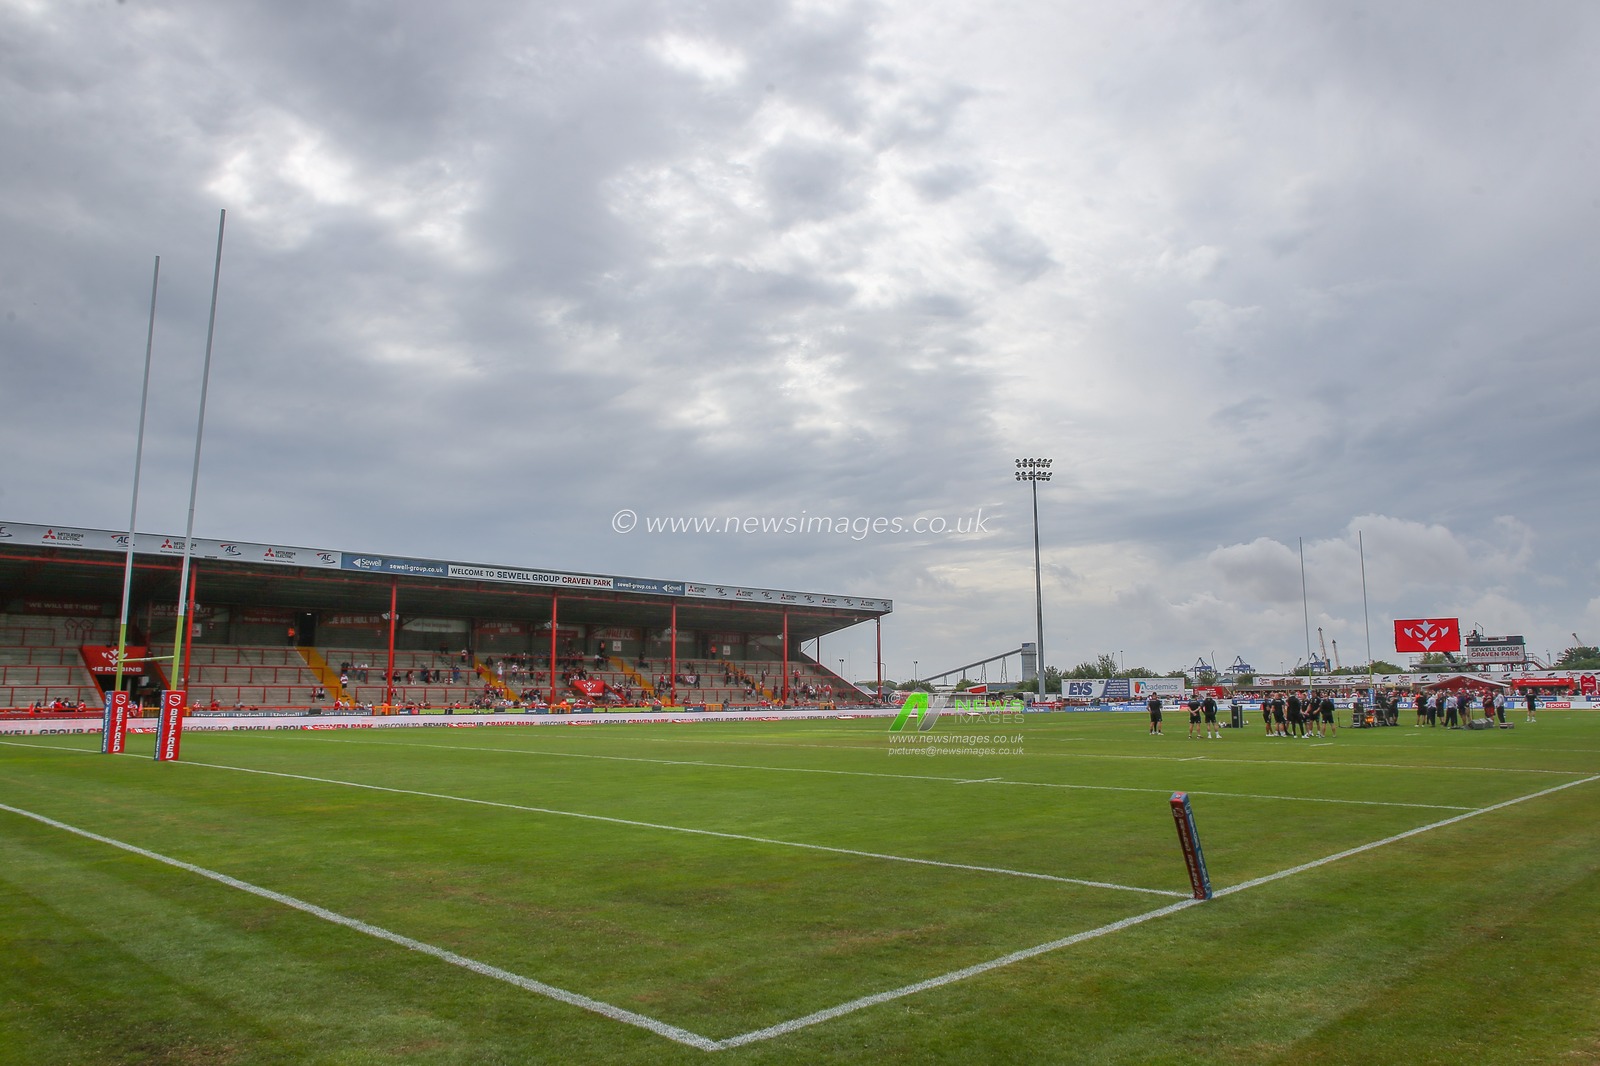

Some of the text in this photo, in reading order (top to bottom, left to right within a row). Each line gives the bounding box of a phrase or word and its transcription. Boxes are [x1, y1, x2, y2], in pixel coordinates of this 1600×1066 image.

[225, 545, 237, 553] AC
[320, 554, 332, 562] AC
[361, 558, 444, 574] Sewell sewell-group.co.uk
[450, 567, 612, 587] WELCOME TO SEWELL GROUP CRAVEN PARK
[1068, 682, 1093, 695] EYS
[1139, 682, 1178, 693] Academics
[112, 706, 124, 752] BETFRED
[165, 708, 179, 759] BETFRED
